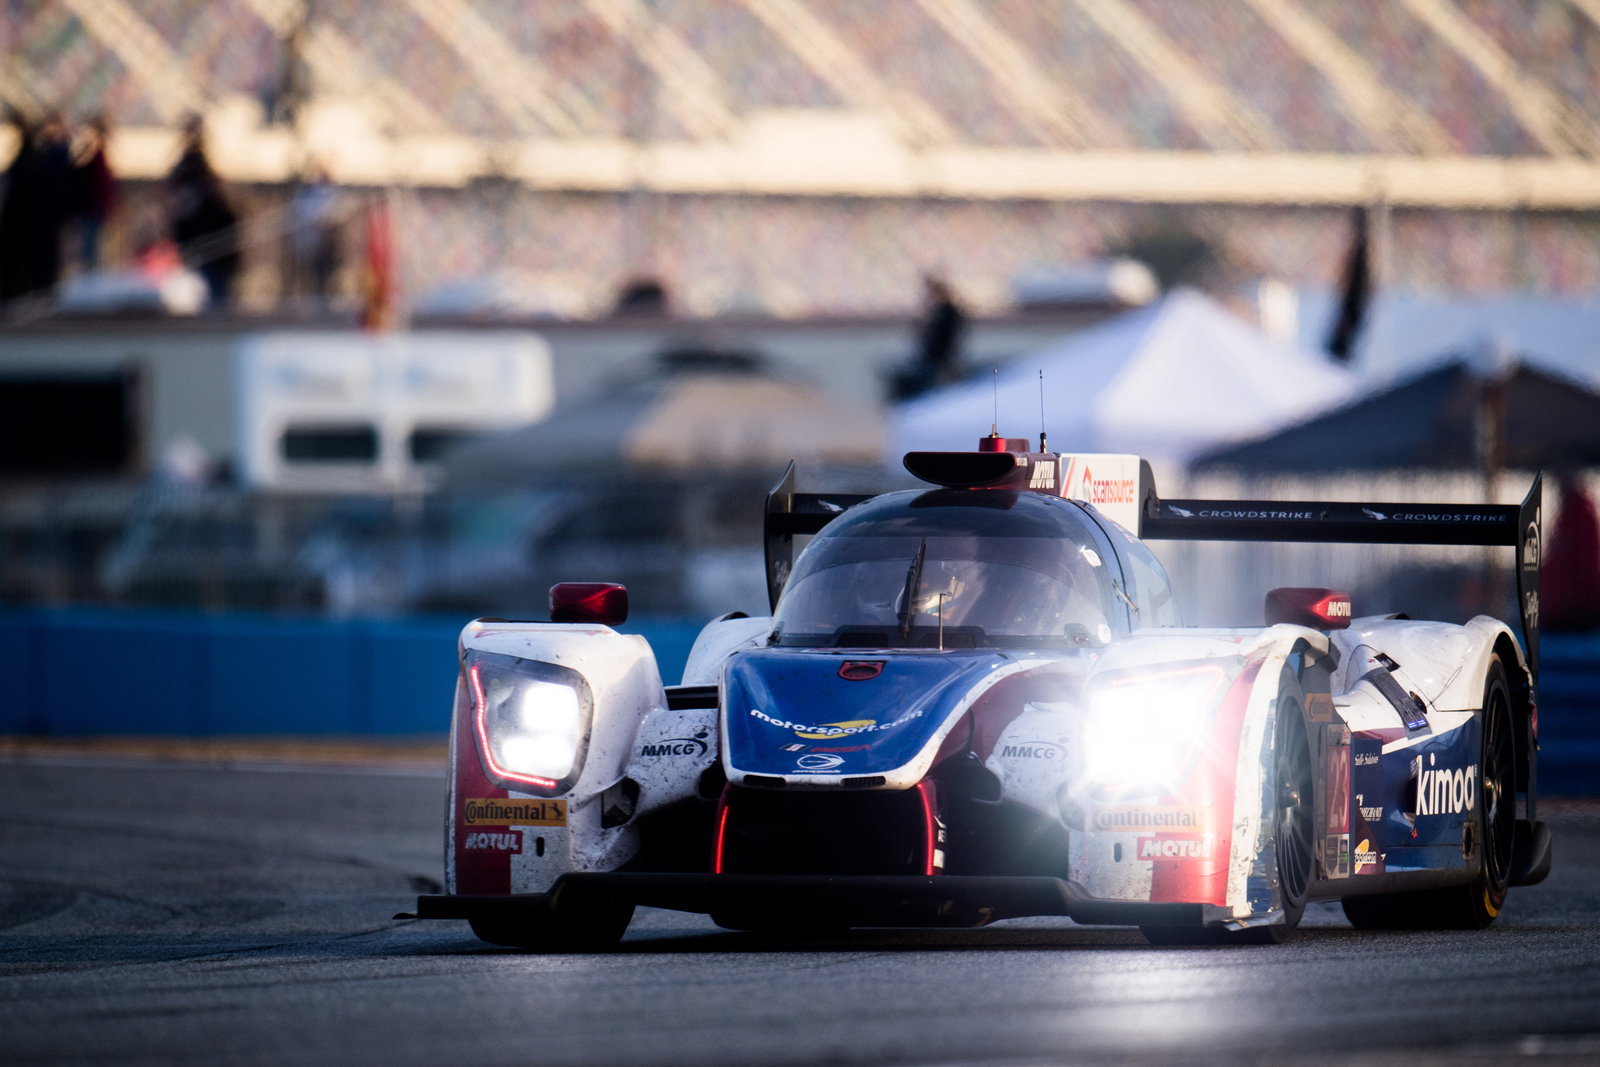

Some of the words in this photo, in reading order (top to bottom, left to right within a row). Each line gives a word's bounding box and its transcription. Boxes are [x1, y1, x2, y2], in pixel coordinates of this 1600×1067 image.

[1093, 480, 1134, 503] scansource
[1199, 510, 1313, 519] CROWDSTRIKE
[1392, 513, 1507, 522] CROWDSTRIKE
[750, 709, 923, 736] motorsport.com
[641, 744, 695, 756] MMCG
[1002, 746, 1056, 759] MMCG
[1329, 750, 1347, 828] 23
[1416, 752, 1475, 815] kimoa
[465, 801, 546, 823] Continental
[1093, 808, 1197, 830] Continental
[465, 833, 520, 850] MOTUL
